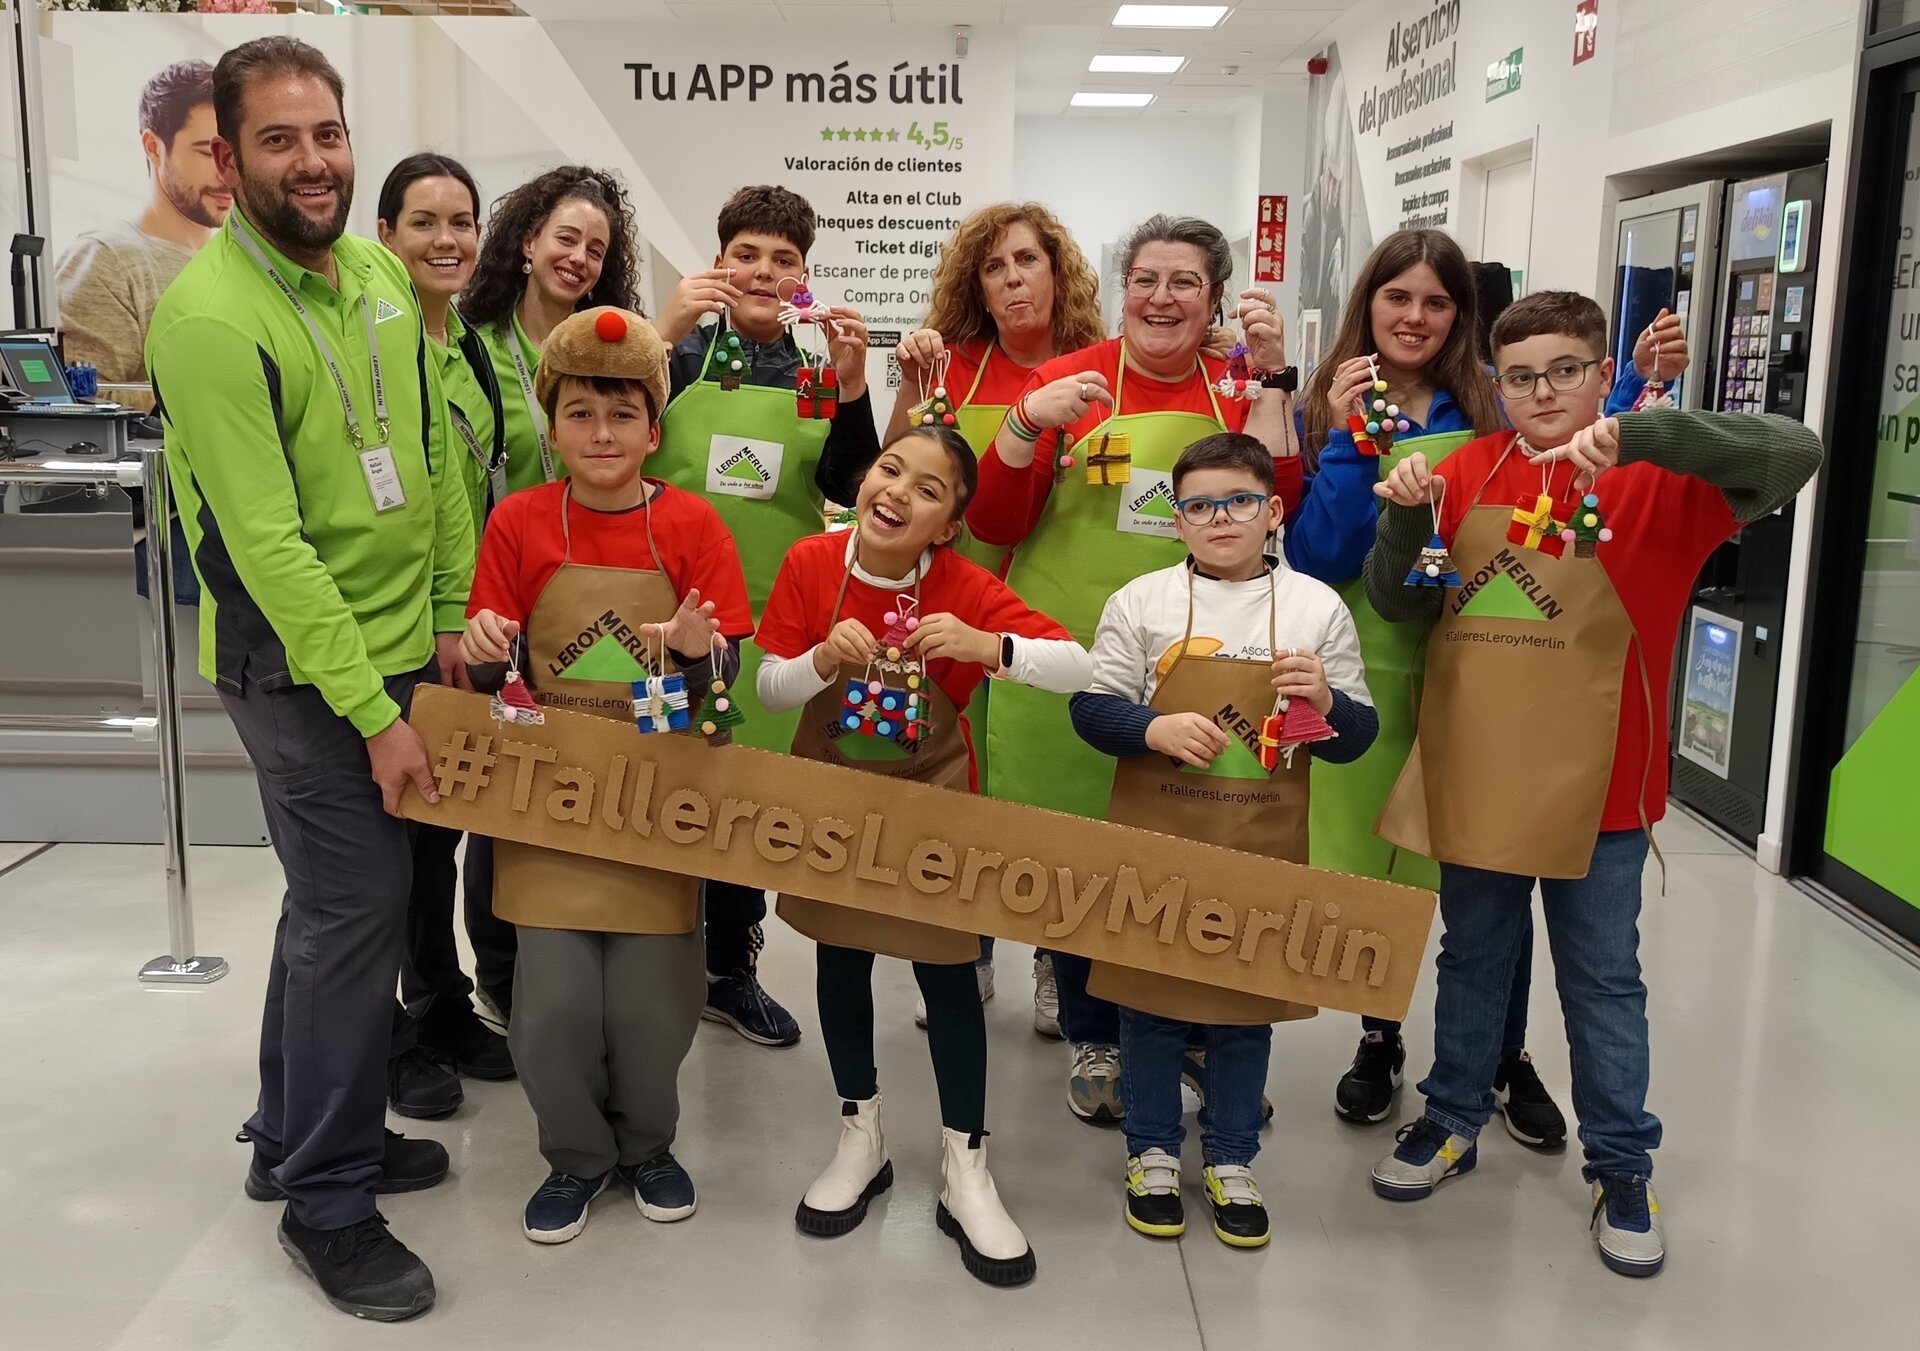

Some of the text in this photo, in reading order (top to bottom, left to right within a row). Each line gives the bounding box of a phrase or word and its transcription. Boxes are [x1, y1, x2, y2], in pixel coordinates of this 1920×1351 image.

[1386, 0, 1459, 72] Al servicio
[624, 60, 963, 104] Tu APP más útil
[1359, 41, 1456, 137] del profesional
[784, 156, 963, 173] Valoración de clientes
[846, 191, 962, 206] Alta en el Club
[816, 214, 874, 232] heques
[855, 240, 943, 258] Ticket digi
[814, 264, 936, 282] Escaner de prec
[844, 289, 904, 305] Compra
[863, 314, 894, 324] licación
[880, 336, 899, 345] Store
[372, 355, 384, 406] LEROY MERLIN
[715, 446, 771, 482] LEROY MERLIN
[1128, 480, 1179, 512] LEROY MERL
[1451, 548, 1563, 620] LEROY MERLIN
[548, 620, 604, 677] LEROY
[1241, 646, 1270, 657] ASOC
[1445, 630, 1565, 650] #TalleresLeroyMerlin
[539, 692, 632, 711] #TalleresLeroy
[822, 720, 921, 754] LER LIN
[1218, 703, 1260, 752] MER
[1160, 783, 1281, 806] #TalleresLeroyMerlin
[433, 731, 1391, 988] #TalleresLeroyMerlin
